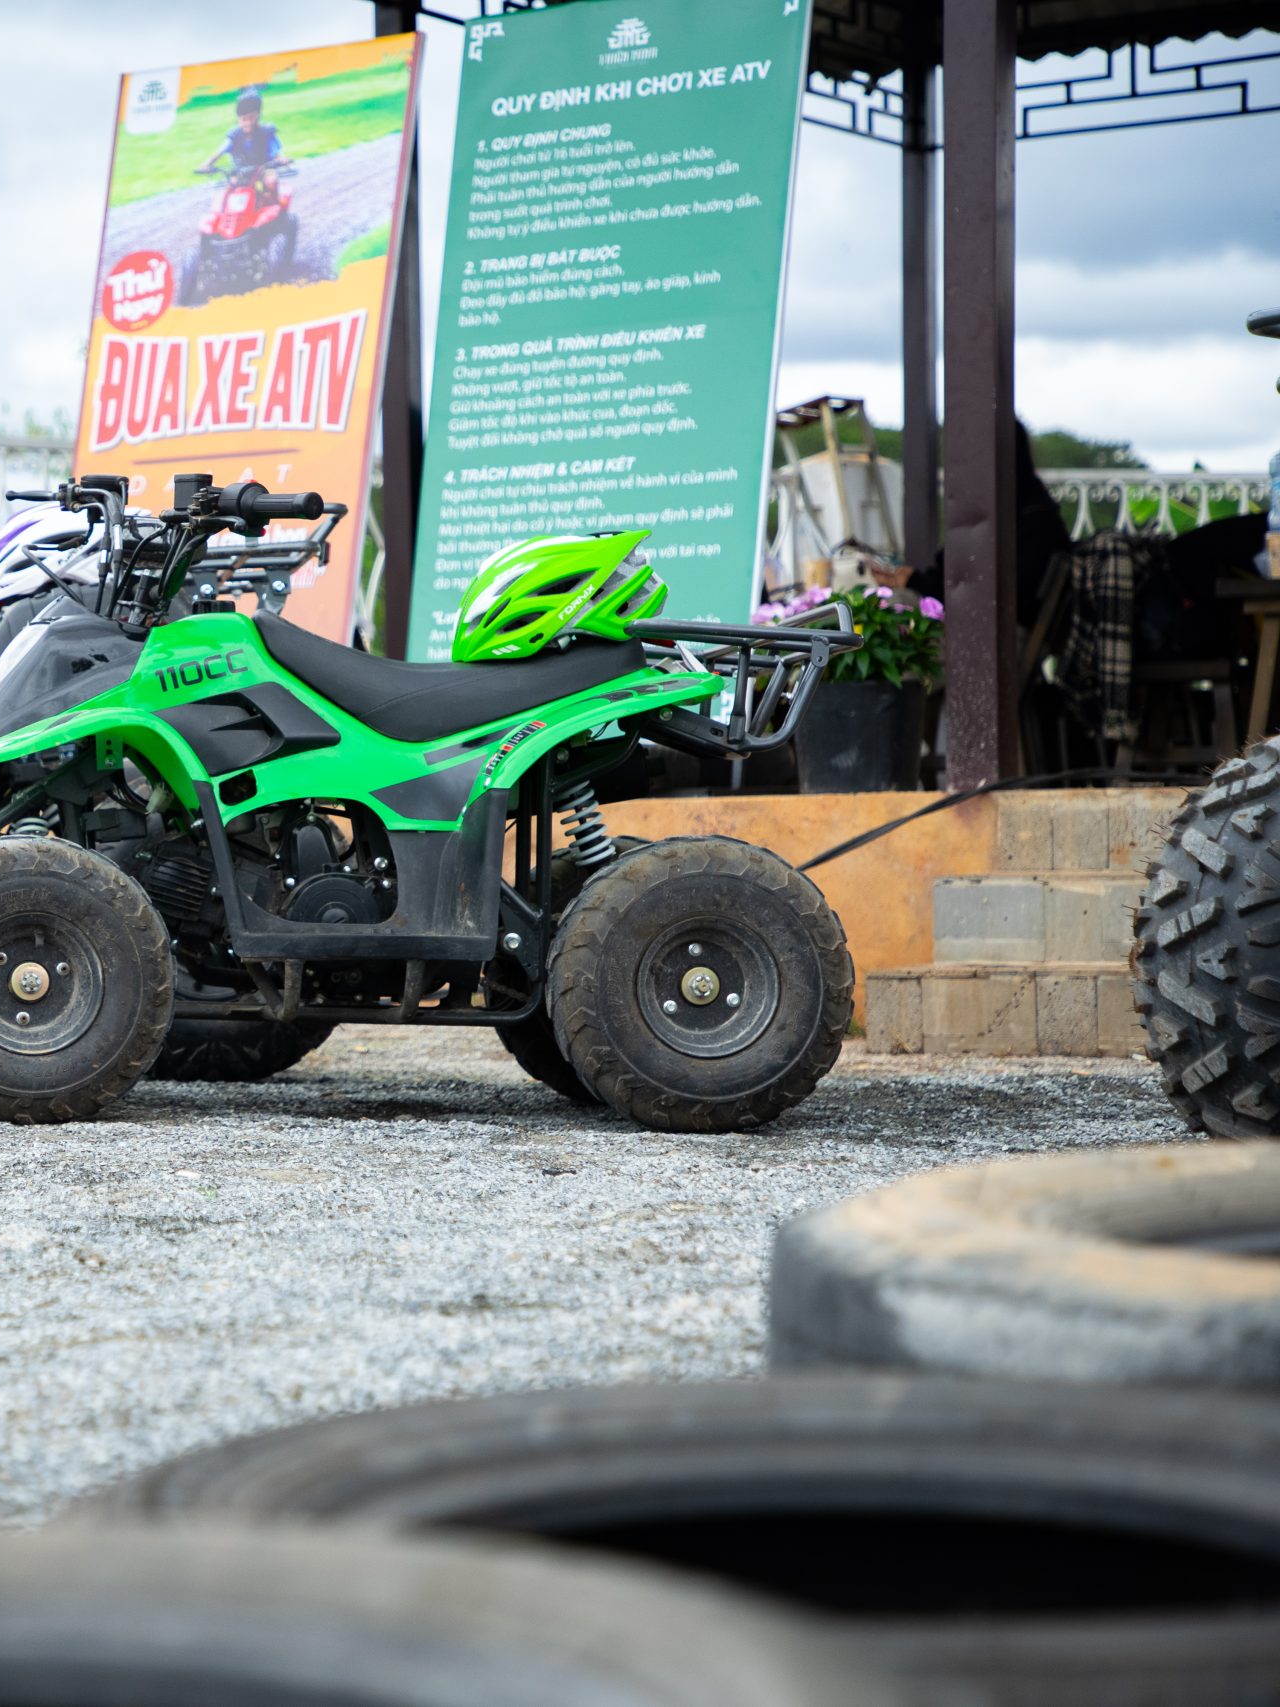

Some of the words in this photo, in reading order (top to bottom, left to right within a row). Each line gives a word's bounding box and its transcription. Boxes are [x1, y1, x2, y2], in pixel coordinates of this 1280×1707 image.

[491, 93, 536, 117] QUY
[539, 86, 590, 111] ĐỊNH
[595, 80, 632, 102] KHI
[636, 71, 693, 96] CHƠI
[697, 66, 726, 88] XE
[730, 60, 771, 83] ATV
[478, 140, 488, 153] 1.
[491, 135, 522, 151] QUY
[559, 123, 611, 142] CHUNG
[463, 261, 478, 275] 2.
[480, 255, 528, 272] TRANG
[455, 348, 470, 362] 3.
[472, 342, 519, 360] TRONG
[684, 324, 705, 340] XE
[186, 330, 265, 432] XE
[257, 308, 368, 433] ATV
[443, 470, 459, 484] 4.
[556, 461, 567, 477] &
[570, 459, 604, 475] CAM
[155, 649, 248, 692] 110CC
